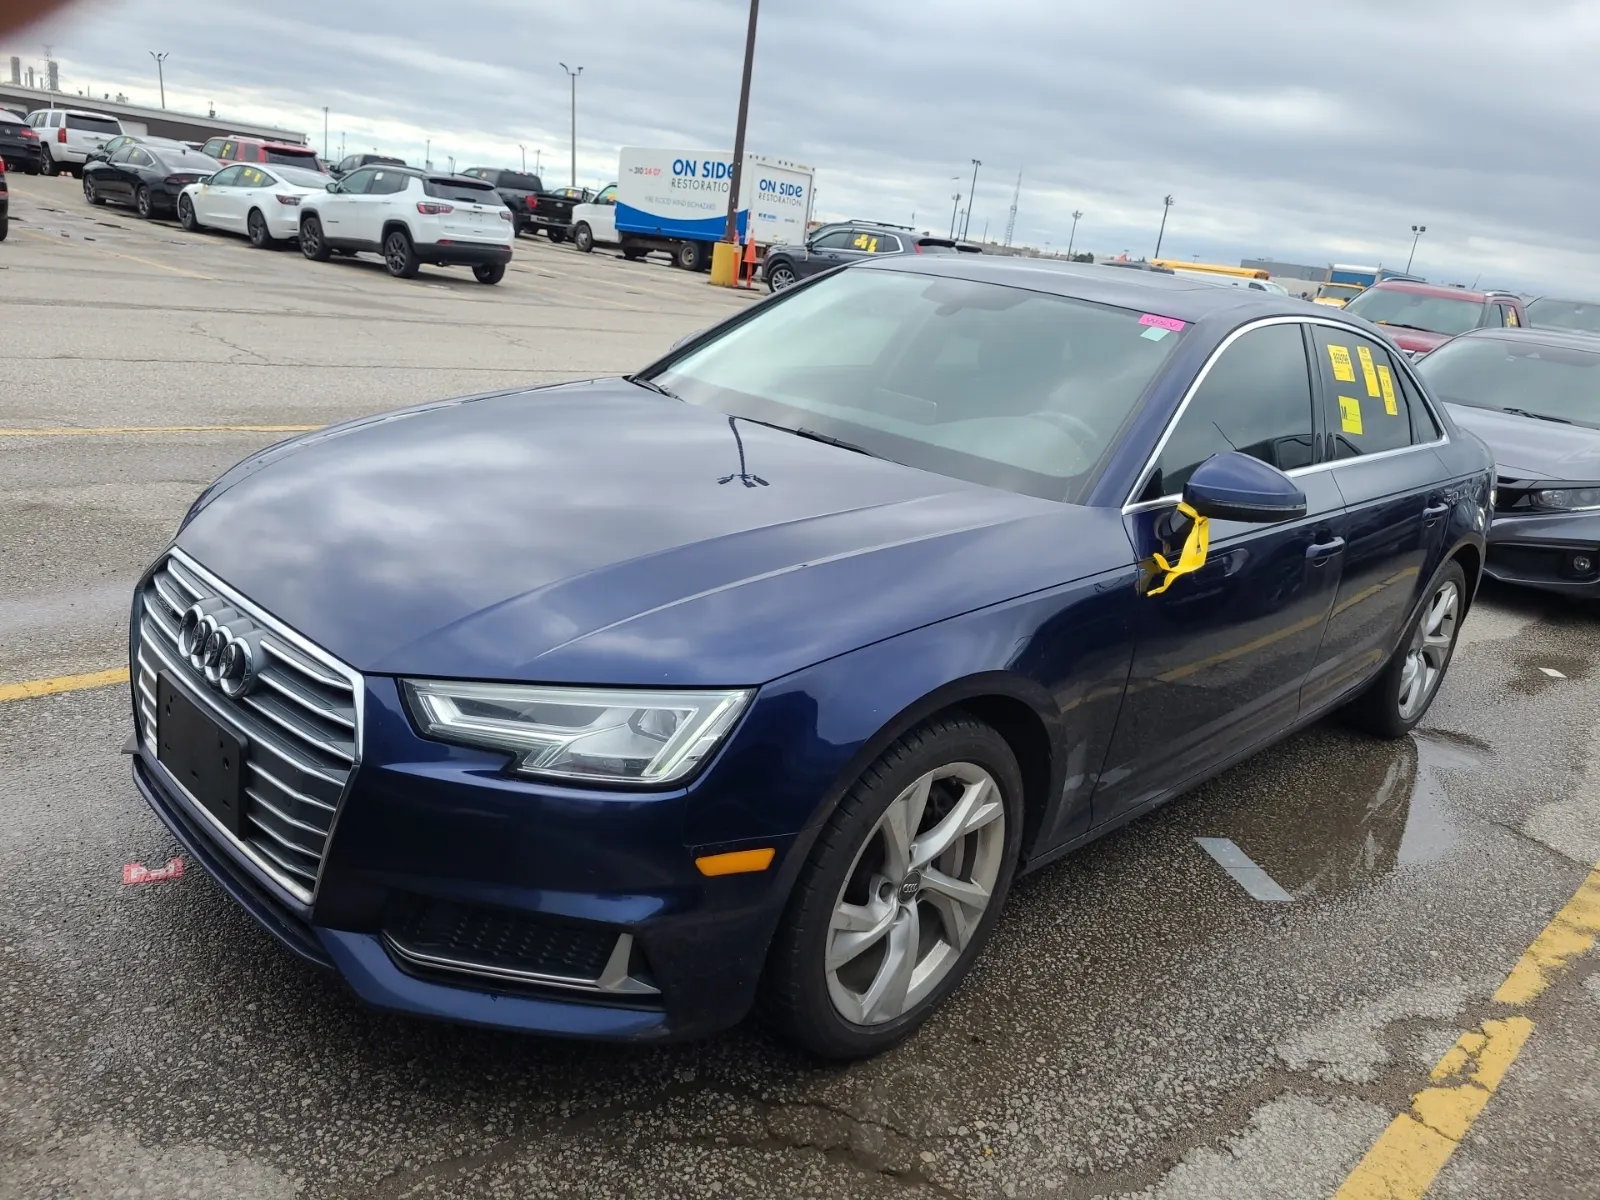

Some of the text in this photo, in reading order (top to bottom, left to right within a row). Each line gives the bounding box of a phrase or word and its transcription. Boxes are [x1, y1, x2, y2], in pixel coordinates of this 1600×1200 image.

[673, 159, 697, 177] ON
[671, 178, 729, 193] RESTORATIO
[759, 179, 776, 193] ON
